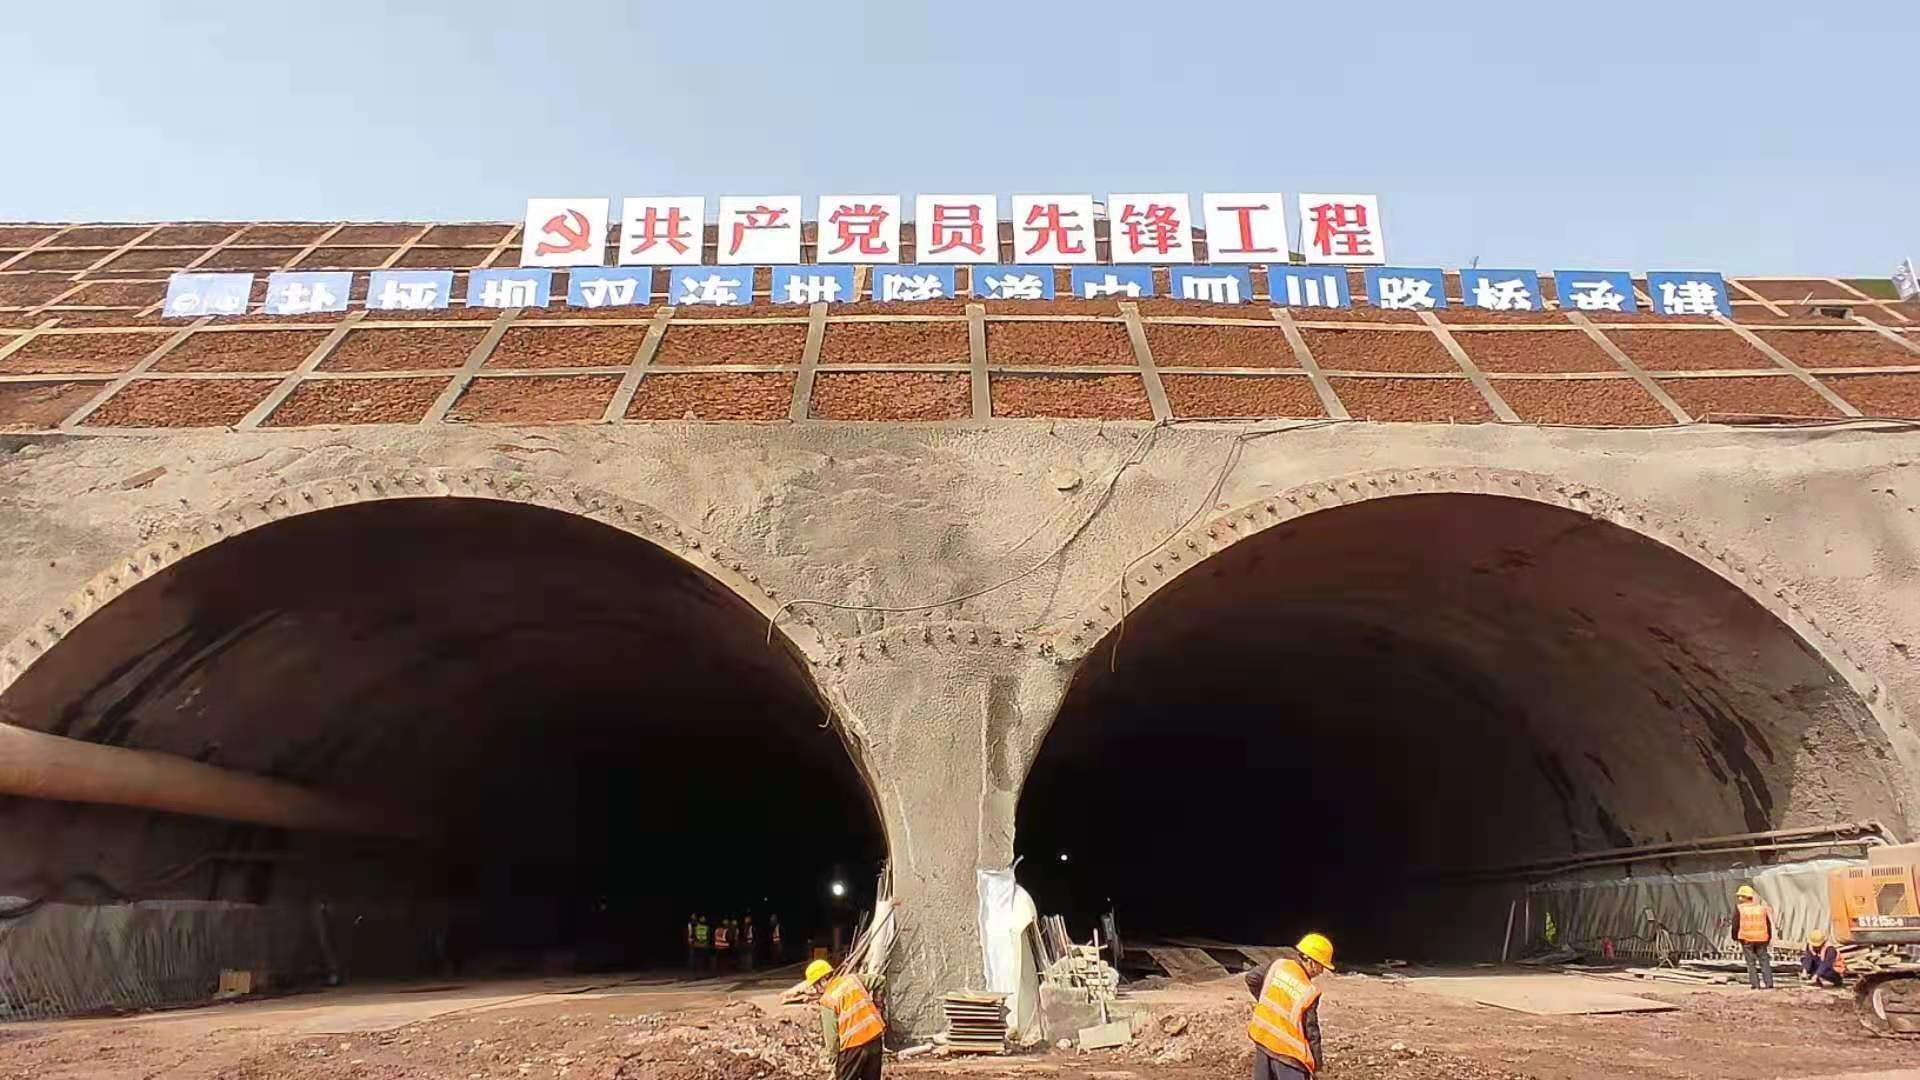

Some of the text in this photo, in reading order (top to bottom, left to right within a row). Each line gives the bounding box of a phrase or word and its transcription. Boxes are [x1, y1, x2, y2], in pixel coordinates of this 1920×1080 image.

[630, 202, 1375, 256] 共产党员先锋工程
